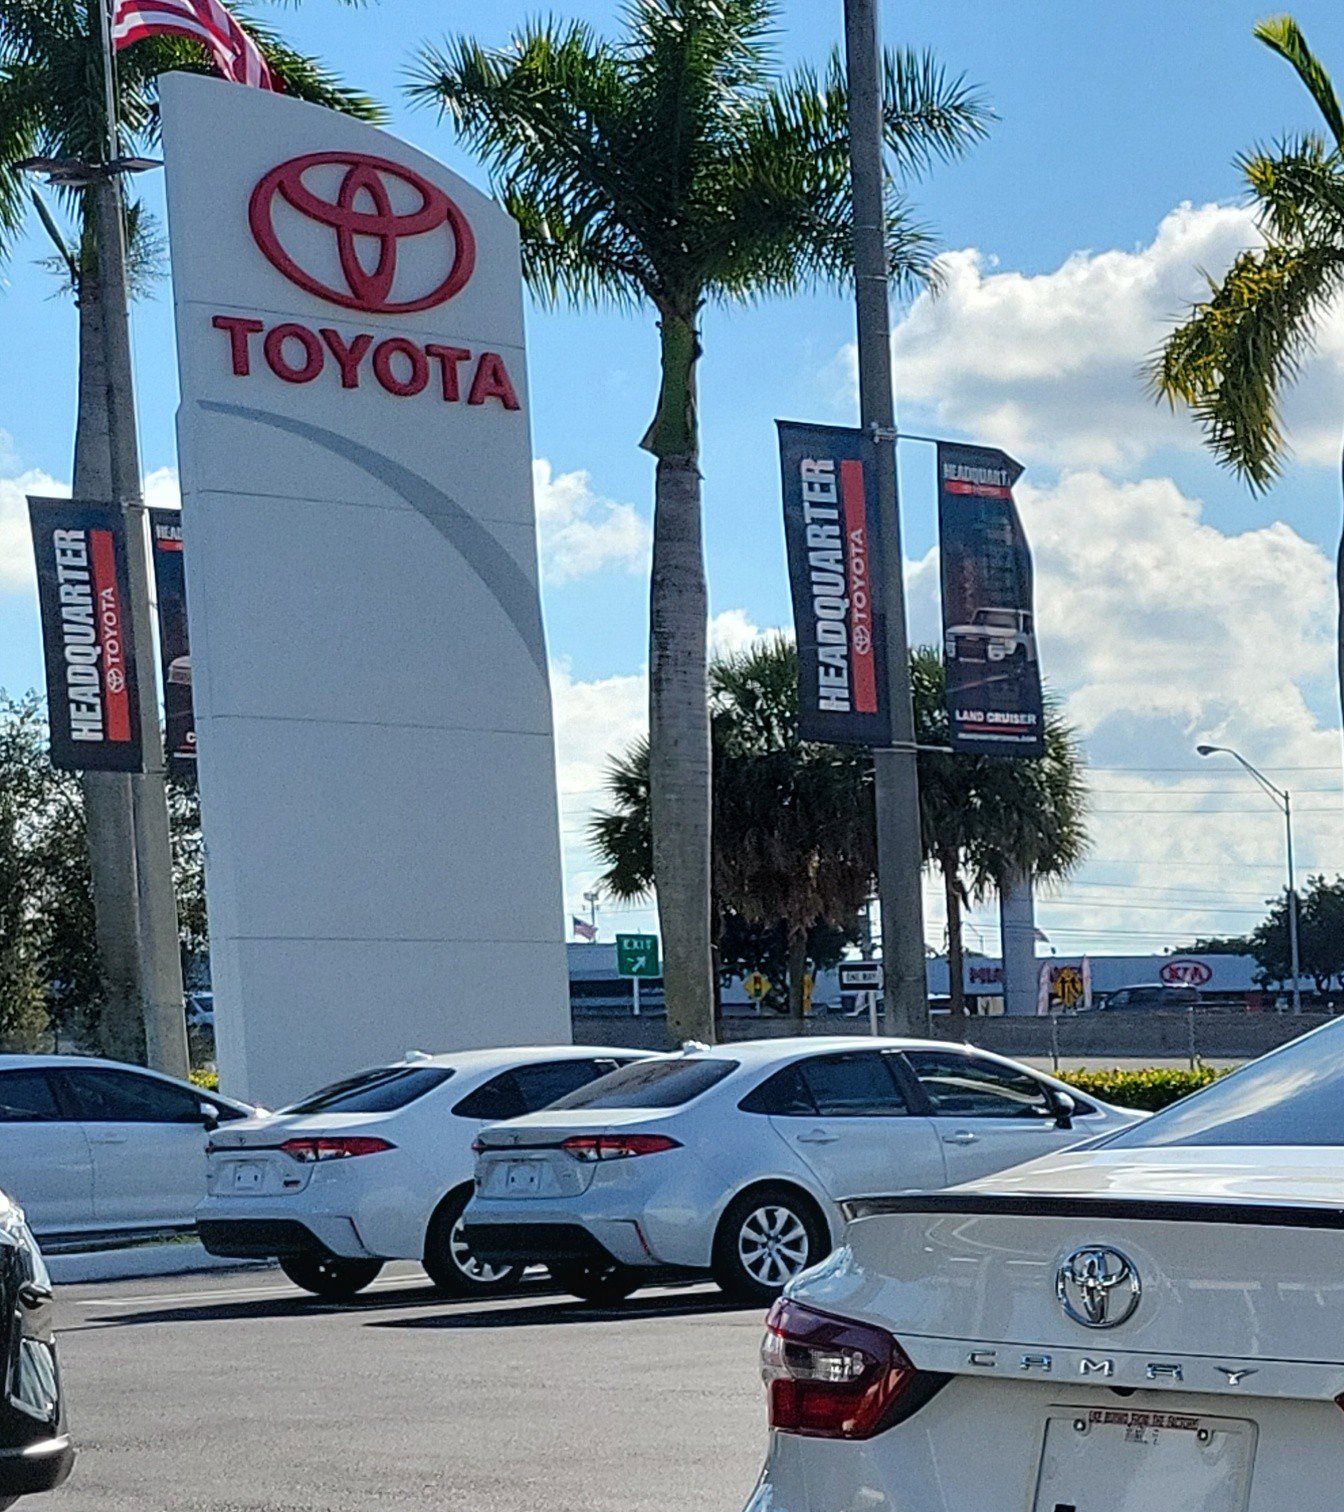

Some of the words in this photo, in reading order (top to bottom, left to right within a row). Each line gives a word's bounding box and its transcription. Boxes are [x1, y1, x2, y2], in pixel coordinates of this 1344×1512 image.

[211, 315, 520, 411] TOYOTA
[801, 458, 850, 711] HEADQUARTER
[852, 528, 867, 622] TOYOTA
[52, 528, 104, 743] HEADQUARTER
[102, 587, 121, 665] TOYOTA
[955, 709, 984, 722] LAND
[986, 711, 1036, 725] CRUISER
[623, 938, 652, 950] EXIT
[967, 1350, 1259, 1385] CAMRY
